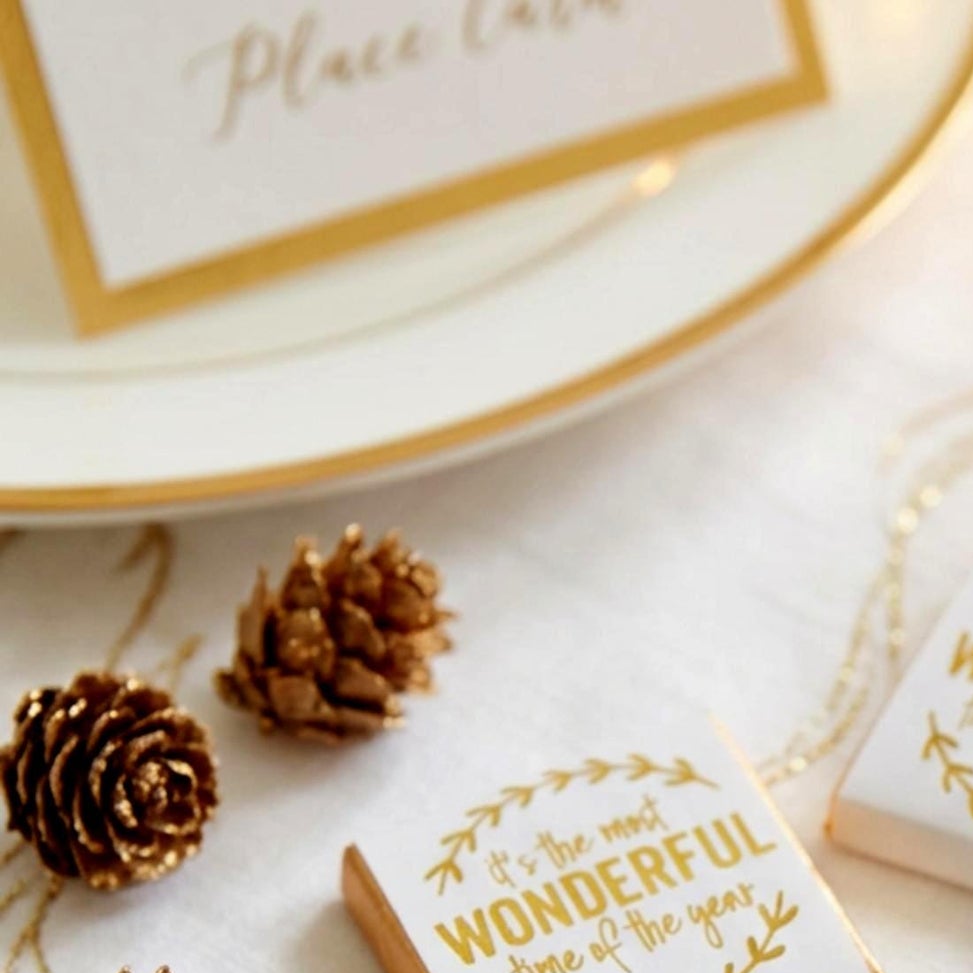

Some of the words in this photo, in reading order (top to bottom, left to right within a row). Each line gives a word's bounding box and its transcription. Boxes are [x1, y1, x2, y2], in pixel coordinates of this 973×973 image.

[434, 812, 777, 966] WONDERFUL
[486, 848, 536, 889] it's
[536, 830, 594, 871] the
[598, 793, 669, 841] most
[624, 909, 682, 952] the
[687, 882, 756, 949] year
